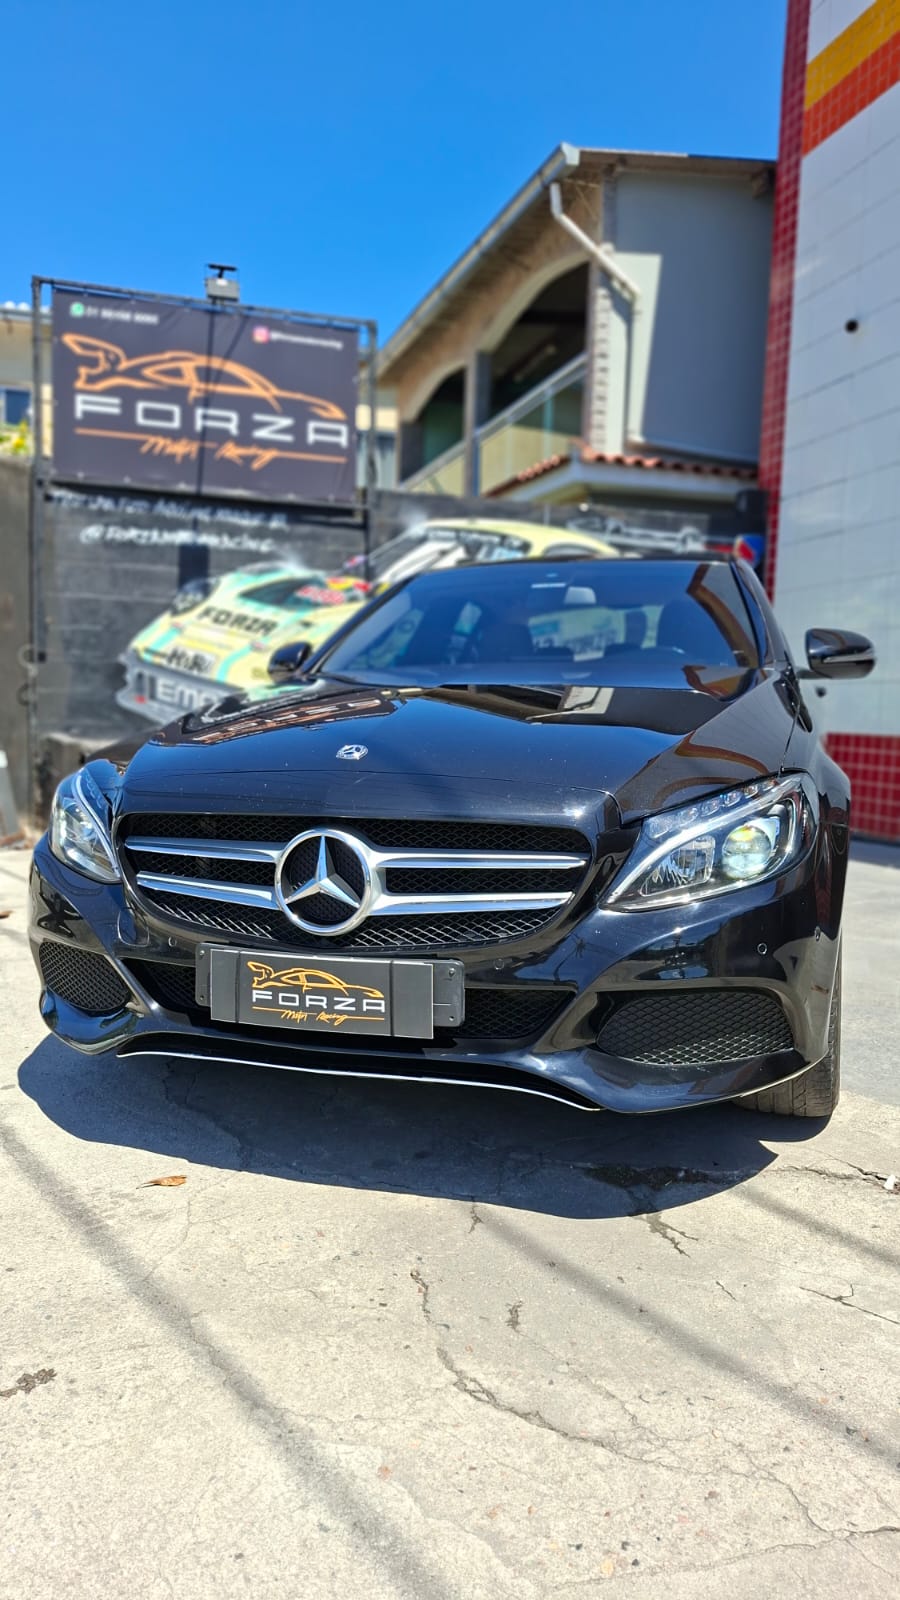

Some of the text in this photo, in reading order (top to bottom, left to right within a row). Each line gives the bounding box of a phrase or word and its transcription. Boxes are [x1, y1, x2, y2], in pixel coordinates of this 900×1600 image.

[74, 394, 349, 448] FORZA
[197, 605, 278, 637] FORZA
[252, 989, 386, 1013] FORZA
